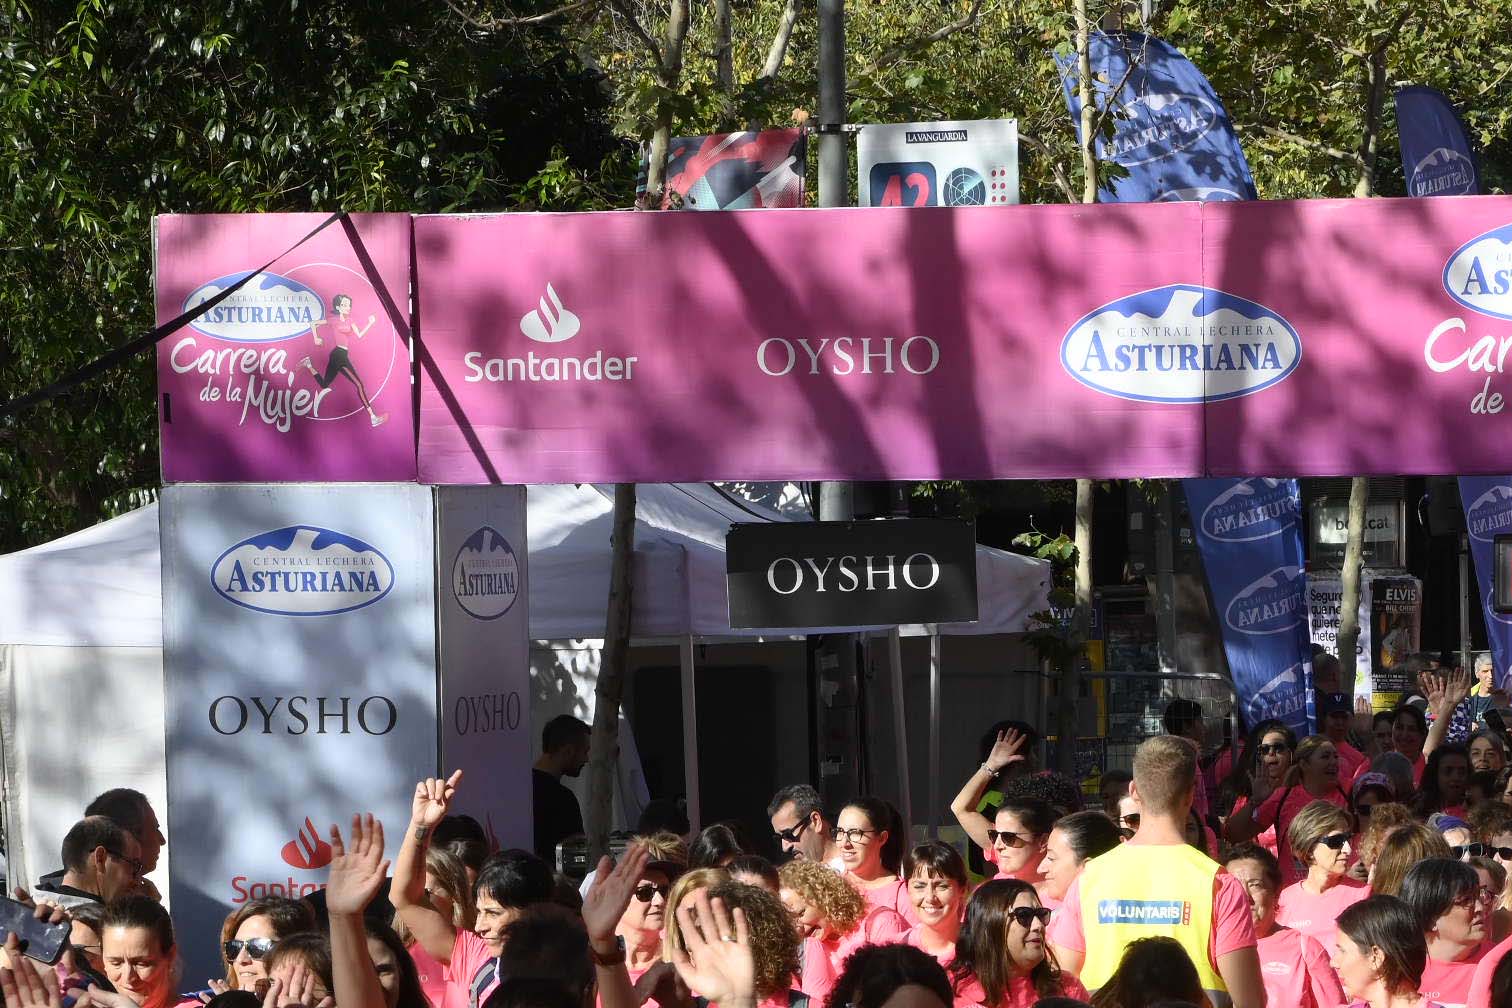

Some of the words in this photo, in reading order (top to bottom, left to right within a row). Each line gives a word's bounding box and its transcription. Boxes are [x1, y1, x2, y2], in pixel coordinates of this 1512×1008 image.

[194, 297, 313, 324] ASTURIANA
[1117, 325, 1192, 337] CENTRAL
[1200, 324, 1275, 336] LECHERA
[171, 337, 287, 374] Carrera
[464, 350, 638, 383] Santander
[757, 335, 940, 376] OYSHO
[1080, 329, 1282, 372] ASTURIANA
[200, 376, 221, 401] de
[227, 376, 243, 402] la
[239, 372, 332, 433] Mujer
[1470, 375, 1504, 414] de
[226, 558, 380, 594] ASTURIANA
[253, 556, 313, 567] CENTRAL
[320, 556, 376, 567] LECHERA
[767, 552, 940, 596] OYSHO
[458, 565, 516, 597] ASTURIANA
[1385, 588, 1416, 601] ELVIS
[207, 695, 397, 736] OYSHO
[455, 692, 520, 736] OYSHO
[231, 876, 328, 903] Santa
[1099, 905, 1181, 919] VOLUNTARIS
